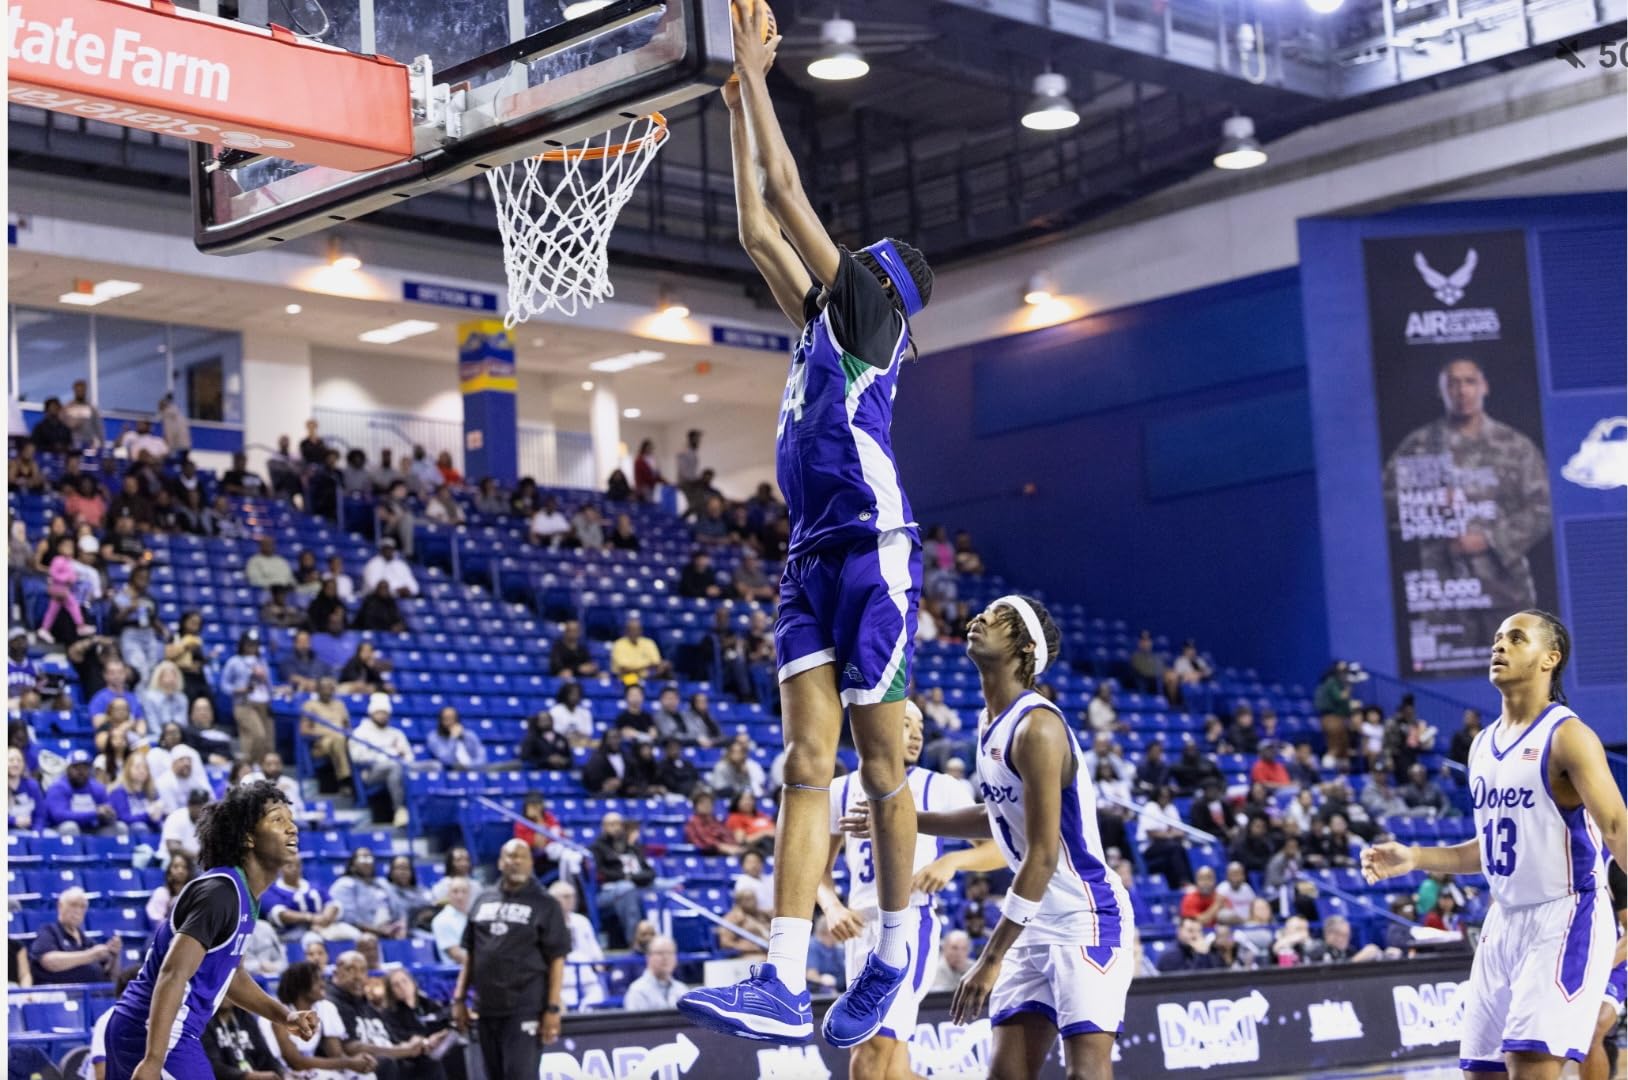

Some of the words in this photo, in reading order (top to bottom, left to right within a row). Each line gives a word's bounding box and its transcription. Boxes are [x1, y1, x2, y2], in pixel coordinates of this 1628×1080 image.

[1405, 310, 1448, 337] AIR
[1398, 488, 1448, 507] MAKE
[1472, 776, 1535, 809] Dover
[995, 815, 1022, 862] 1
[1483, 817, 1517, 876] 13
[859, 841, 875, 883] 3
[1157, 992, 1268, 1052] DART
